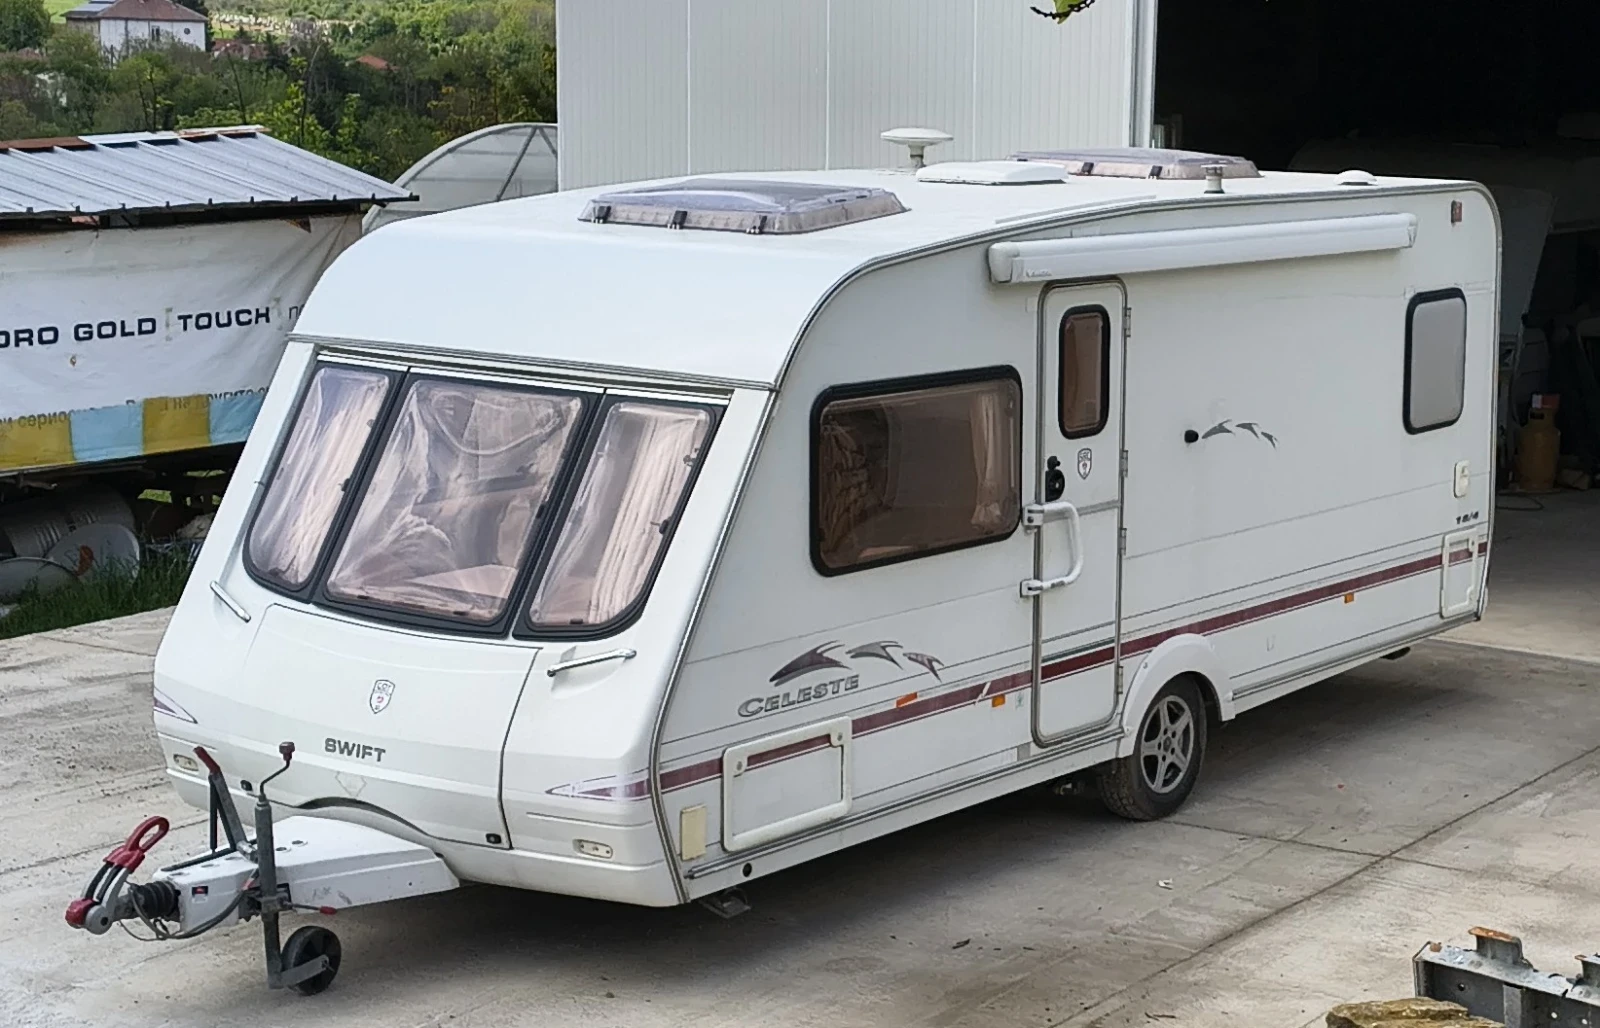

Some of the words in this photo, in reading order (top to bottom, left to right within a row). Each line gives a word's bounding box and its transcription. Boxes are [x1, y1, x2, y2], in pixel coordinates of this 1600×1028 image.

[73, 317, 157, 342] GOLD
[177, 306, 271, 332] TOUCH
[737, 674, 860, 717] CELESTE
[324, 737, 386, 762] SWIFT
